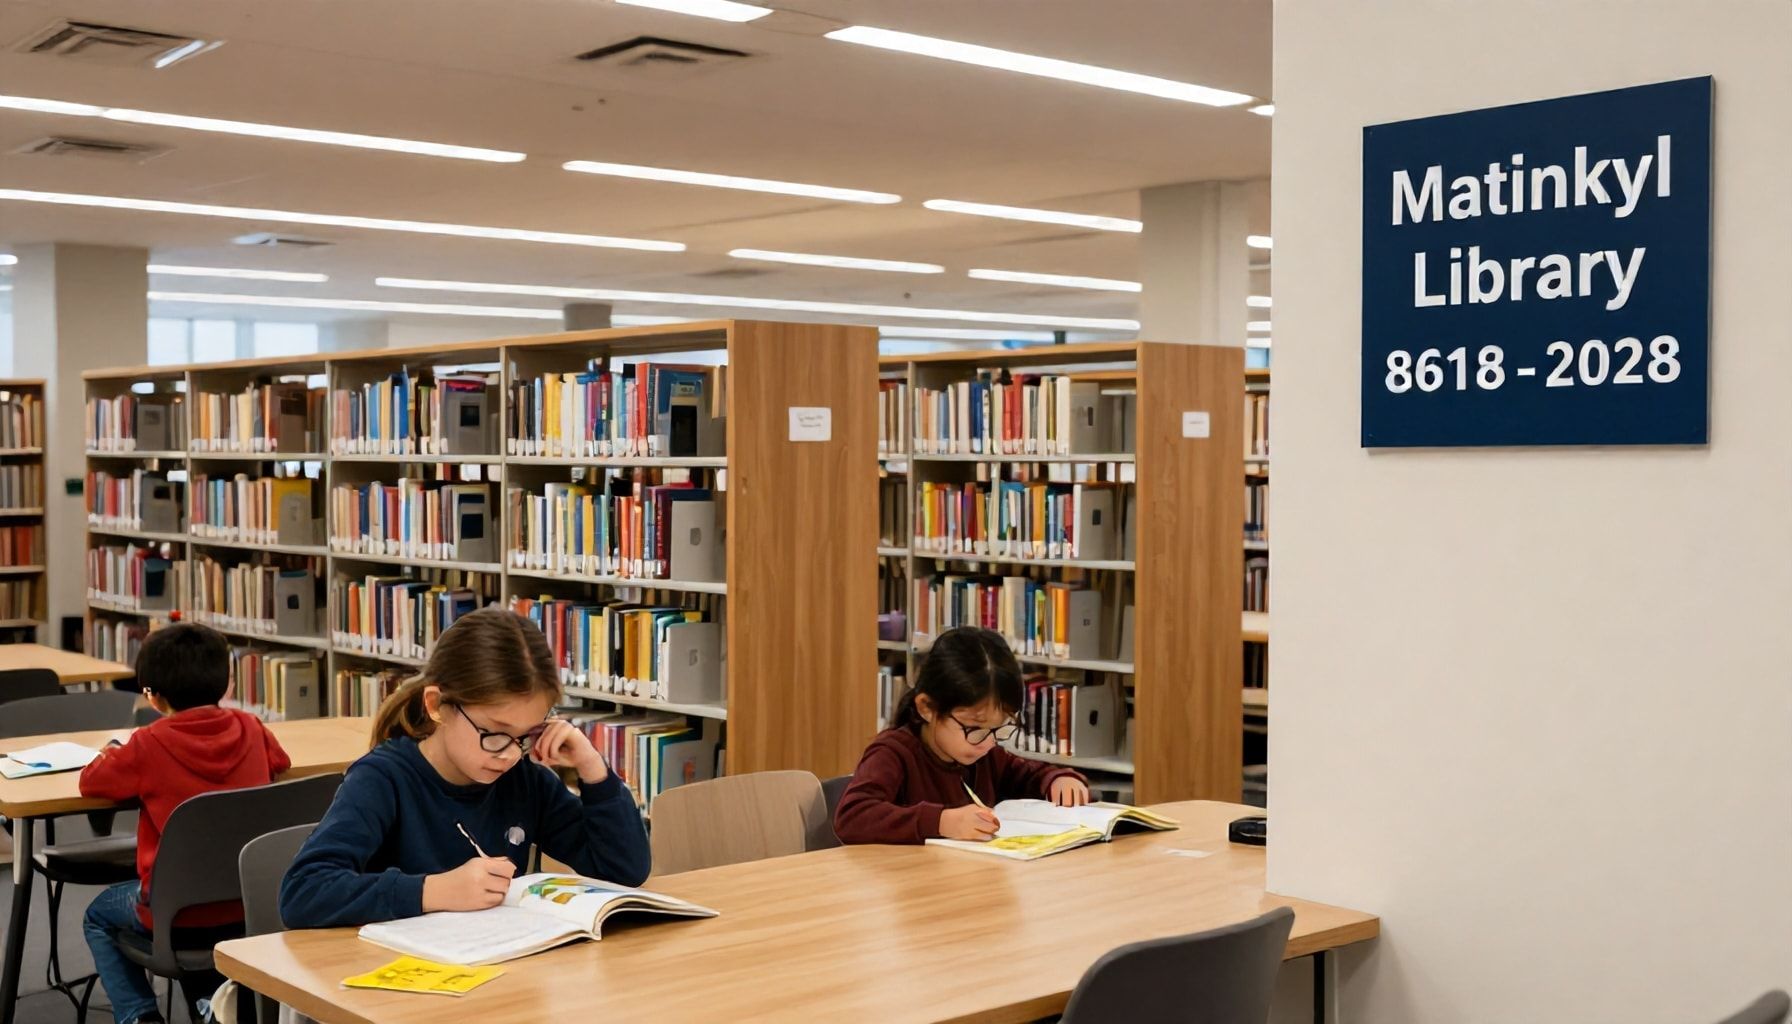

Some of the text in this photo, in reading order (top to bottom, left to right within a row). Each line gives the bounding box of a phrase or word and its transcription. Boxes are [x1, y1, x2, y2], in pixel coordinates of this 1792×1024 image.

[1392, 134, 1671, 225] Matinkyl
[1414, 246, 1647, 311] Library
[1385, 345, 1506, 394] 8618
[1545, 334, 1681, 388] 2028
